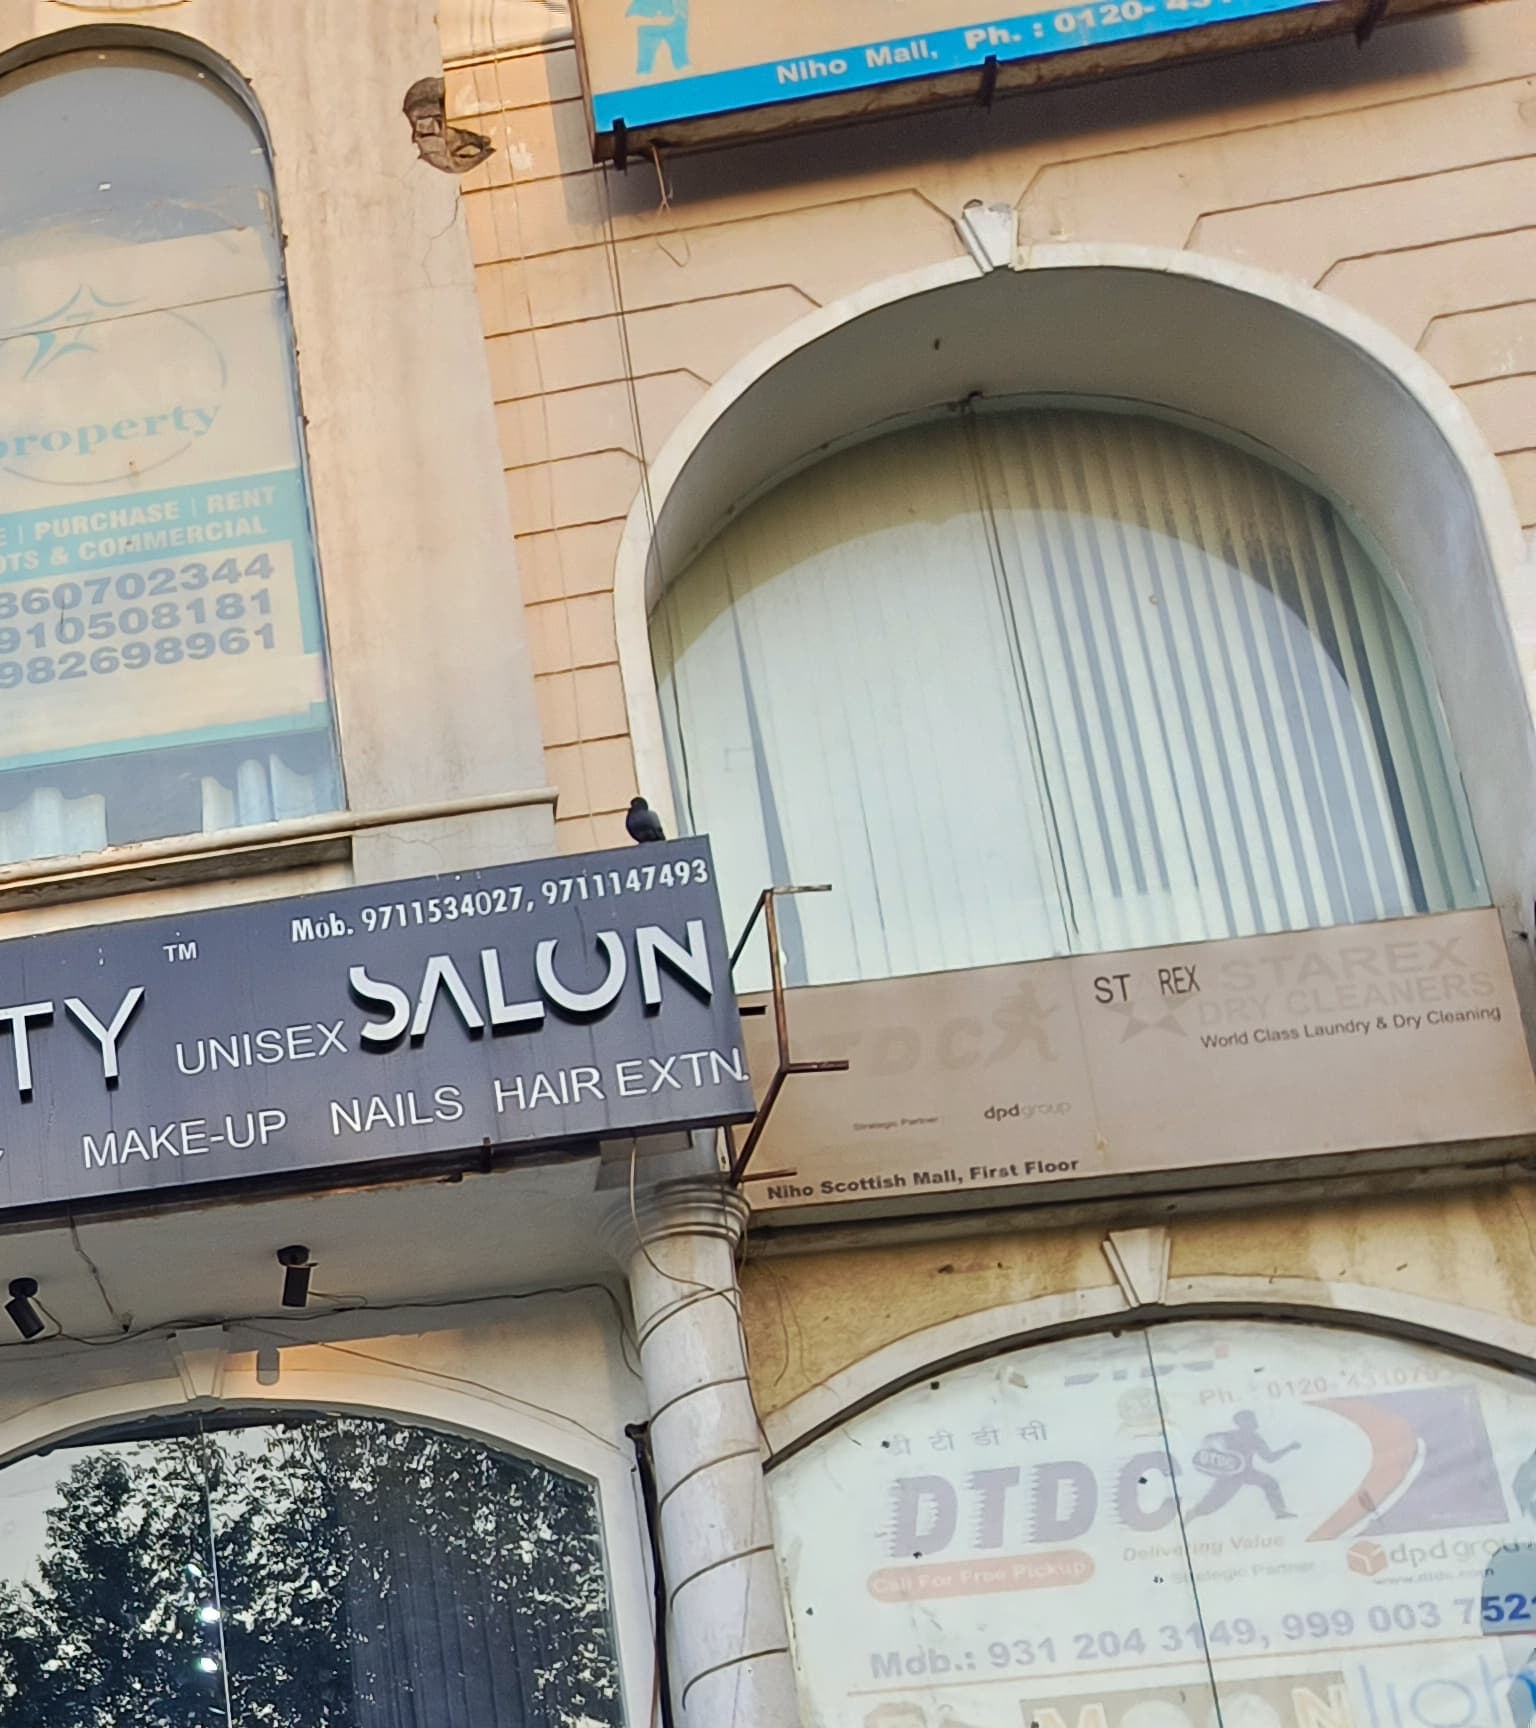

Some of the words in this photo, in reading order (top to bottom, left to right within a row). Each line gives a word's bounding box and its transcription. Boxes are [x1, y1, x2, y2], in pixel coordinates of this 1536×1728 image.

[776, 57, 848, 84] Niho
[866, 40, 938, 69] Mall,
[965, 27, 1022, 52] Ph.
[34, 498, 180, 541] PURCHASE
[207, 485, 278, 514] RENT
[78, 516, 268, 562] COMMERCIAL
[291, 914, 355, 943] Mob.
[361, 887, 534, 933] 9711534027,
[541, 859, 709, 905] 9711147493
[174, 1020, 349, 1076] UNISEX
[348, 920, 715, 1046] SALON
[1201, 1031, 1249, 1050] World
[1253, 1026, 1300, 1044] Class
[1303, 1018, 1370, 1040] Laundry
[1393, 1012, 1423, 1032] Dry
[1427, 1005, 1502, 1027] Cleaning
[82, 1109, 288, 1170] MAKE-UP
[330, 1085, 464, 1137] NAILS
[493, 1065, 607, 1115] HAIR
[616, 1047, 750, 1099] EXTN.
[767, 1183, 814, 1201] Niho
[821, 1173, 907, 1195] Scottish
[970, 1164, 1020, 1182] First
[1025, 1158, 1080, 1176] Floor
[891, 1451, 1183, 1558] DTDC
[989, 1637, 1057, 1669] 931
[1073, 1628, 1146, 1661] 204
[1282, 1610, 1356, 1643] 999
[1369, 1601, 1442, 1632] 003
